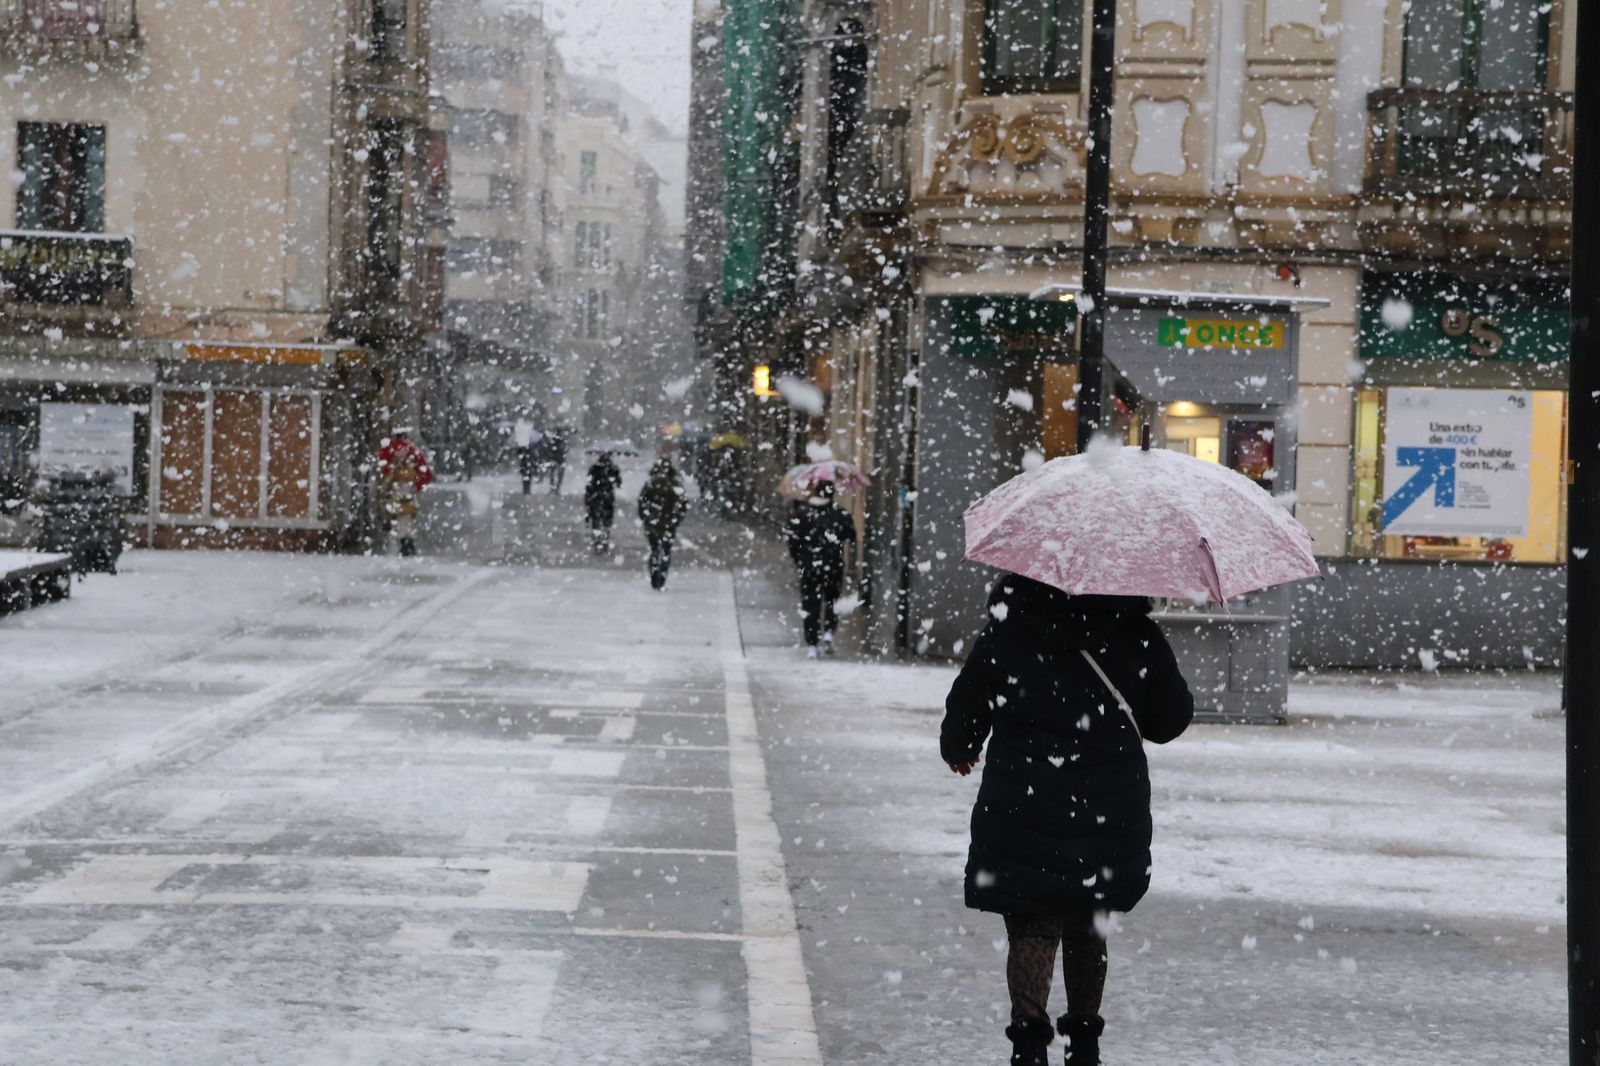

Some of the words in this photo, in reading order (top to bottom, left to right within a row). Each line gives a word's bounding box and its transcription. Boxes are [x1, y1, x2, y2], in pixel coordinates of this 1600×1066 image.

[1196, 324, 1273, 345] ONCE
[1429, 422, 1451, 433] Una
[1429, 435, 1443, 444] de
[1478, 448, 1513, 458] hablar
[1459, 461, 1479, 470] con
